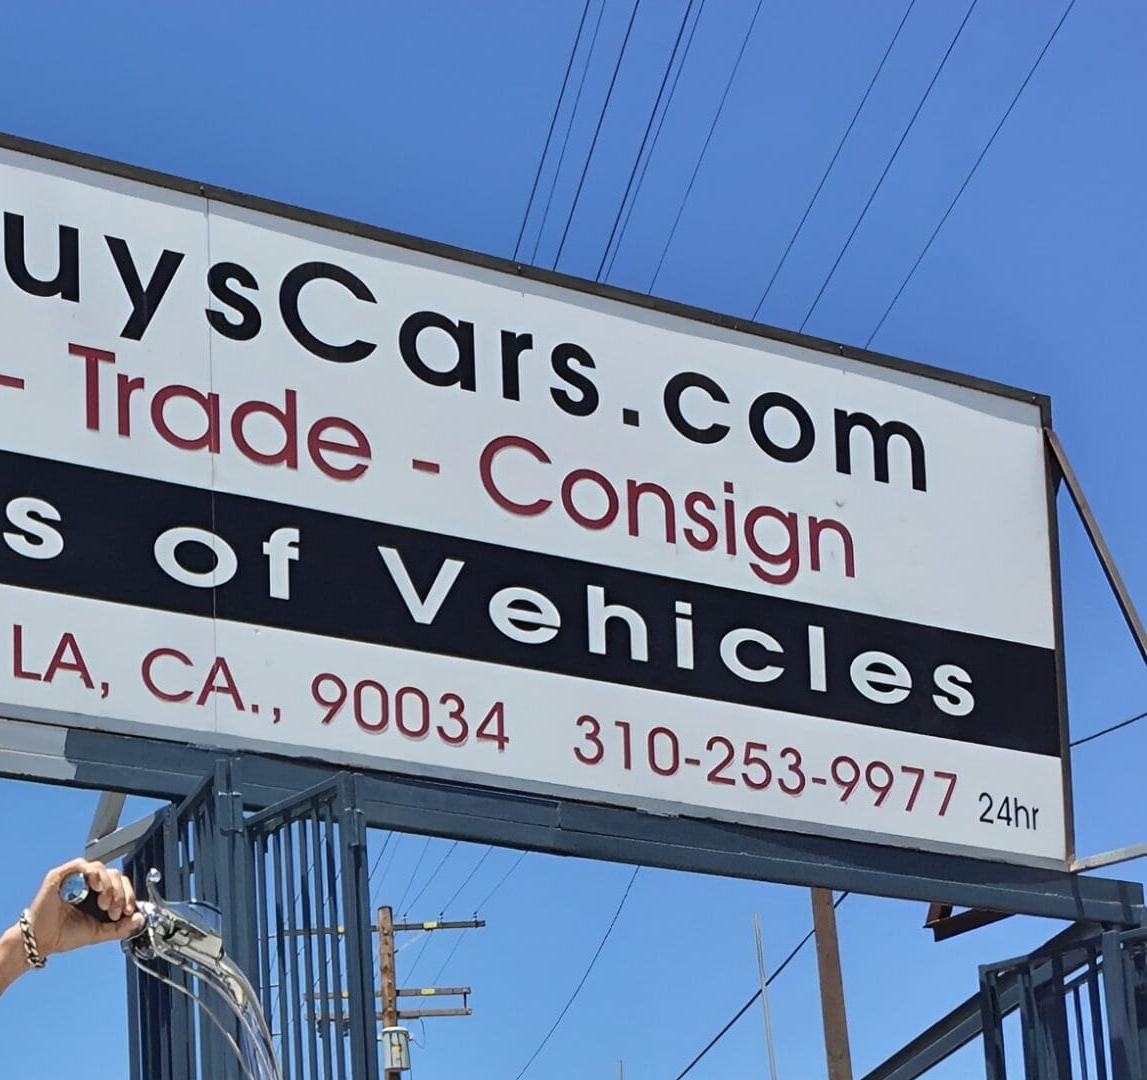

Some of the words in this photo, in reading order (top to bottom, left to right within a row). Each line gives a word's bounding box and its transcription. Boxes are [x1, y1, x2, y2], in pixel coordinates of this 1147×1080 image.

[68, 342, 372, 482] Trade
[412, 458, 440, 474] -
[479, 434, 856, 585] Consign
[154, 526, 301, 600] of
[377, 545, 976, 717] Vehicles
[13, 624, 111, 700] LA,
[141, 647, 281, 725] CA.,
[311, 672, 511, 753] 90034
[574, 714, 959, 818] 310-253-9977
[978, 791, 1039, 831] 24hr
